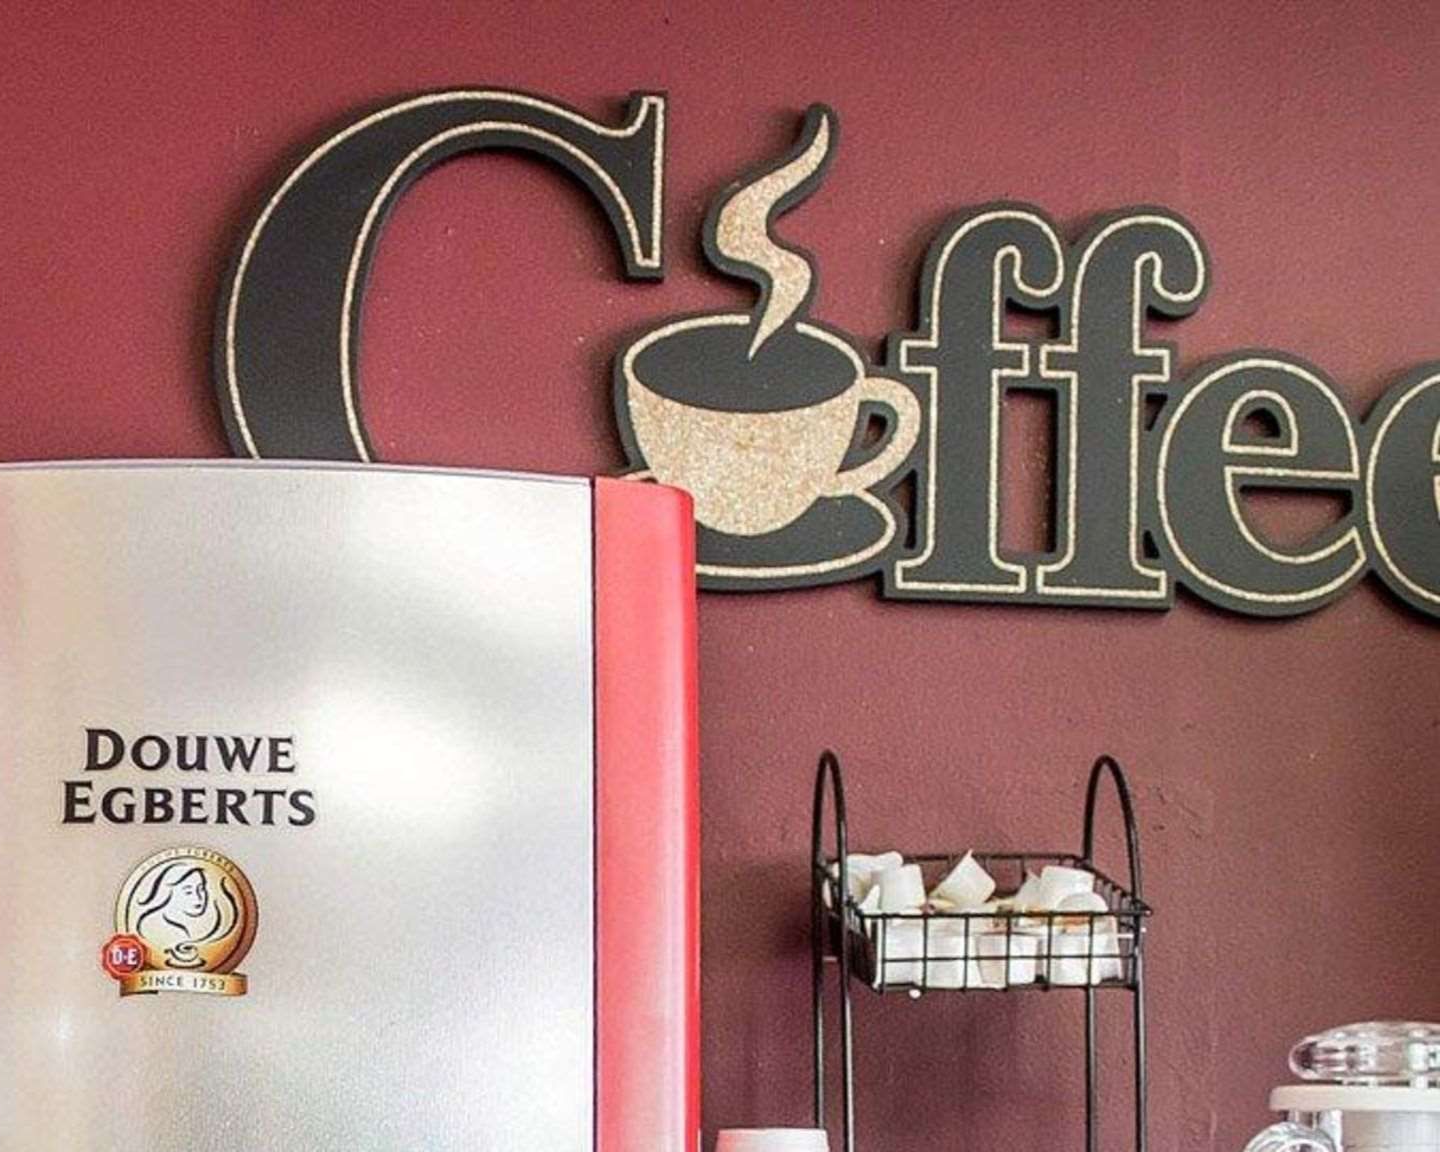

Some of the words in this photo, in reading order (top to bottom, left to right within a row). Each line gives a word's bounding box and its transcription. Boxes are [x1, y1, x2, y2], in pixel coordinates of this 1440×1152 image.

[84, 728, 296, 772] DOUWE
[62, 780, 316, 826] EGBERTS
[139, 976, 185, 988] SINCE
